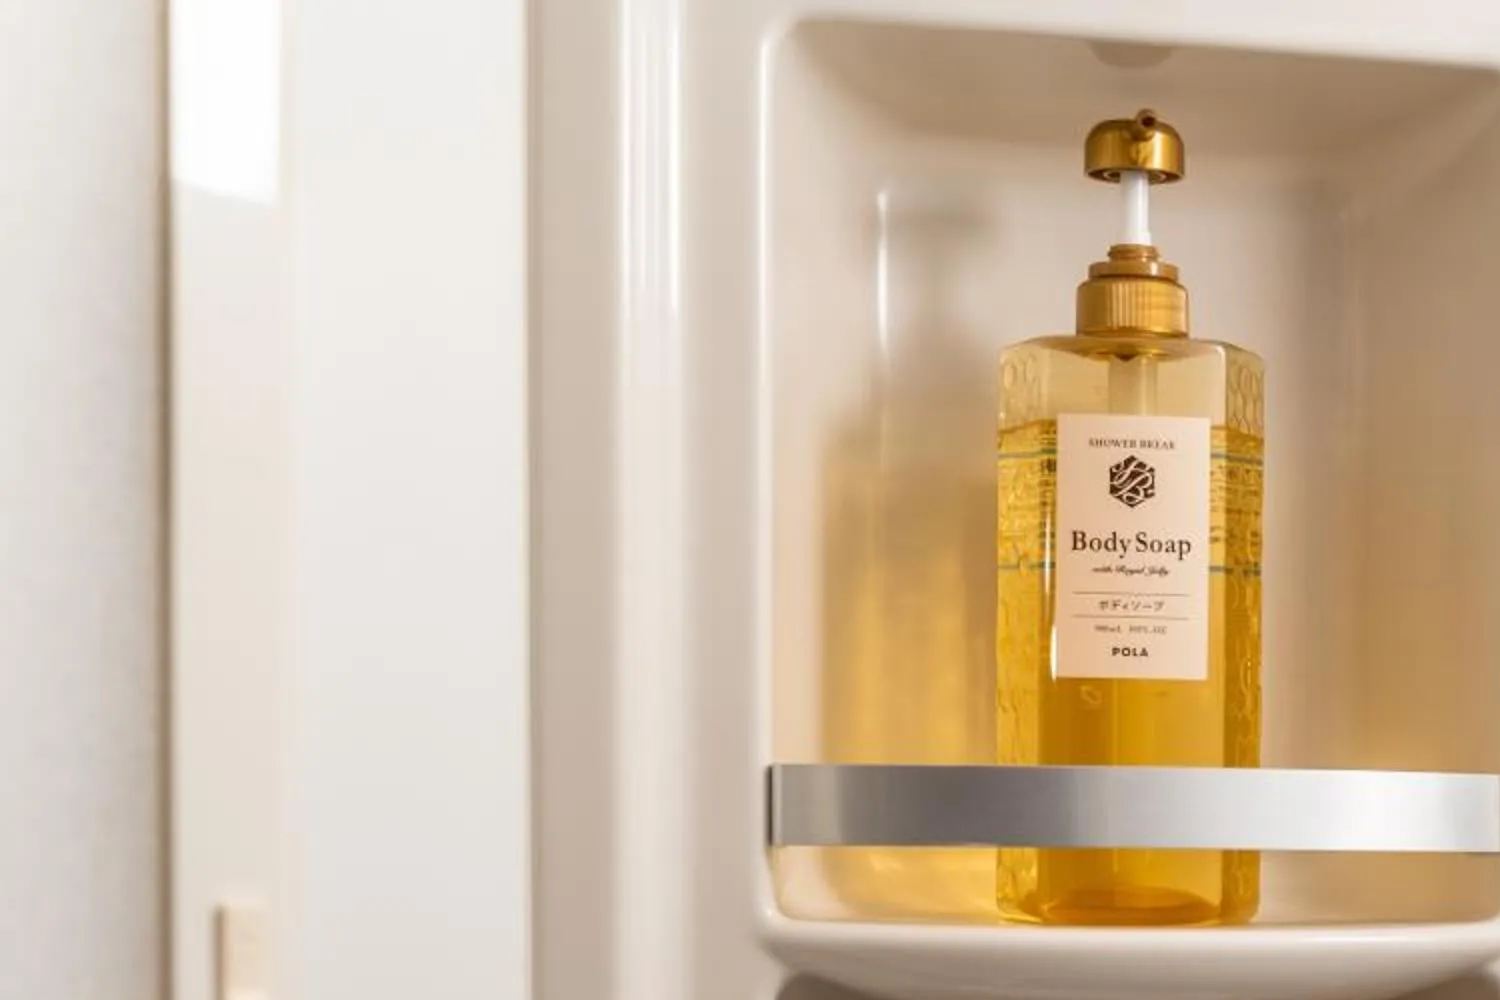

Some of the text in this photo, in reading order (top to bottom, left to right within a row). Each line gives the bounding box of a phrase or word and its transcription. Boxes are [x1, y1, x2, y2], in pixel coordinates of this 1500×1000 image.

[1071, 530, 1192, 561] Body Soap
[1111, 647, 1149, 657] POLA
